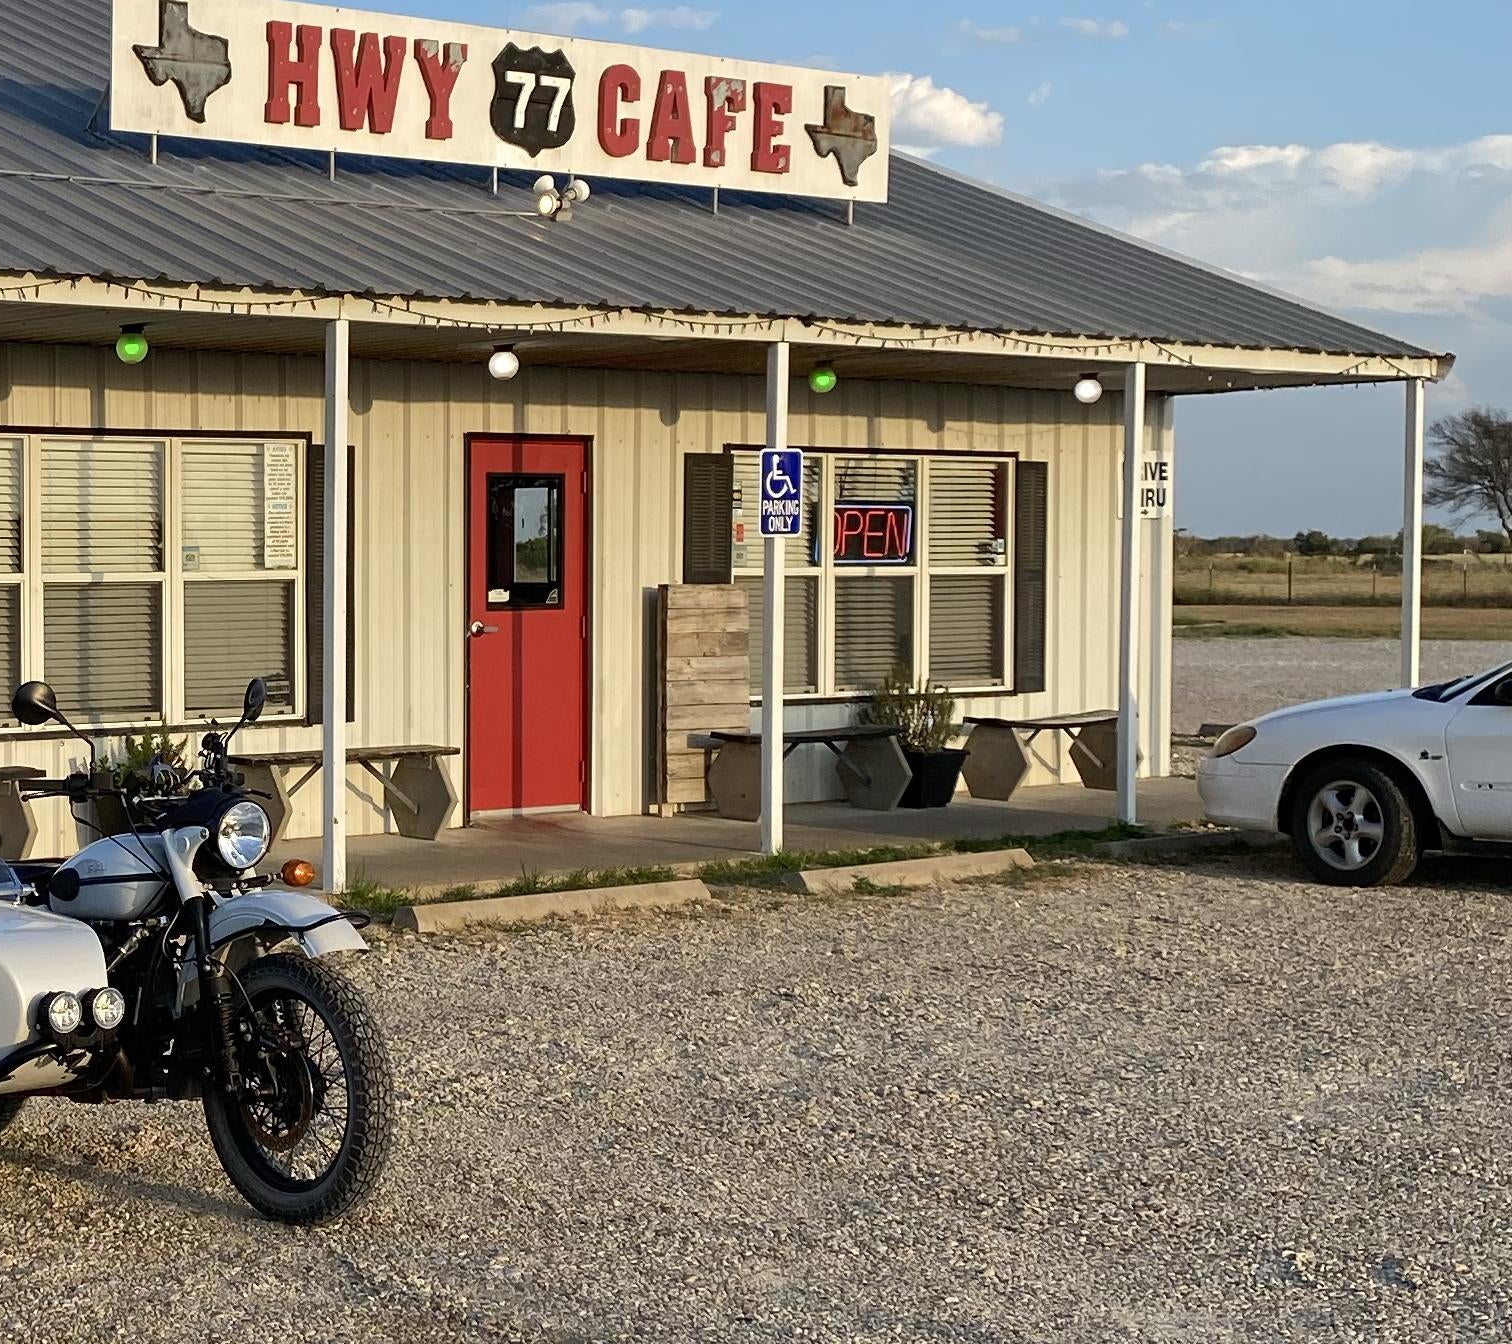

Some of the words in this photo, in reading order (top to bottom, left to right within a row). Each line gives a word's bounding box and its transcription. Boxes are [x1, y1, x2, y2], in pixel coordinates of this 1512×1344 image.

[264, 20, 468, 140] HWY
[505, 70, 571, 132] 77
[597, 64, 793, 175] CAFE
[1140, 488, 1166, 507] RU
[762, 500, 800, 516] PARKING
[768, 515, 794, 532] ONLY
